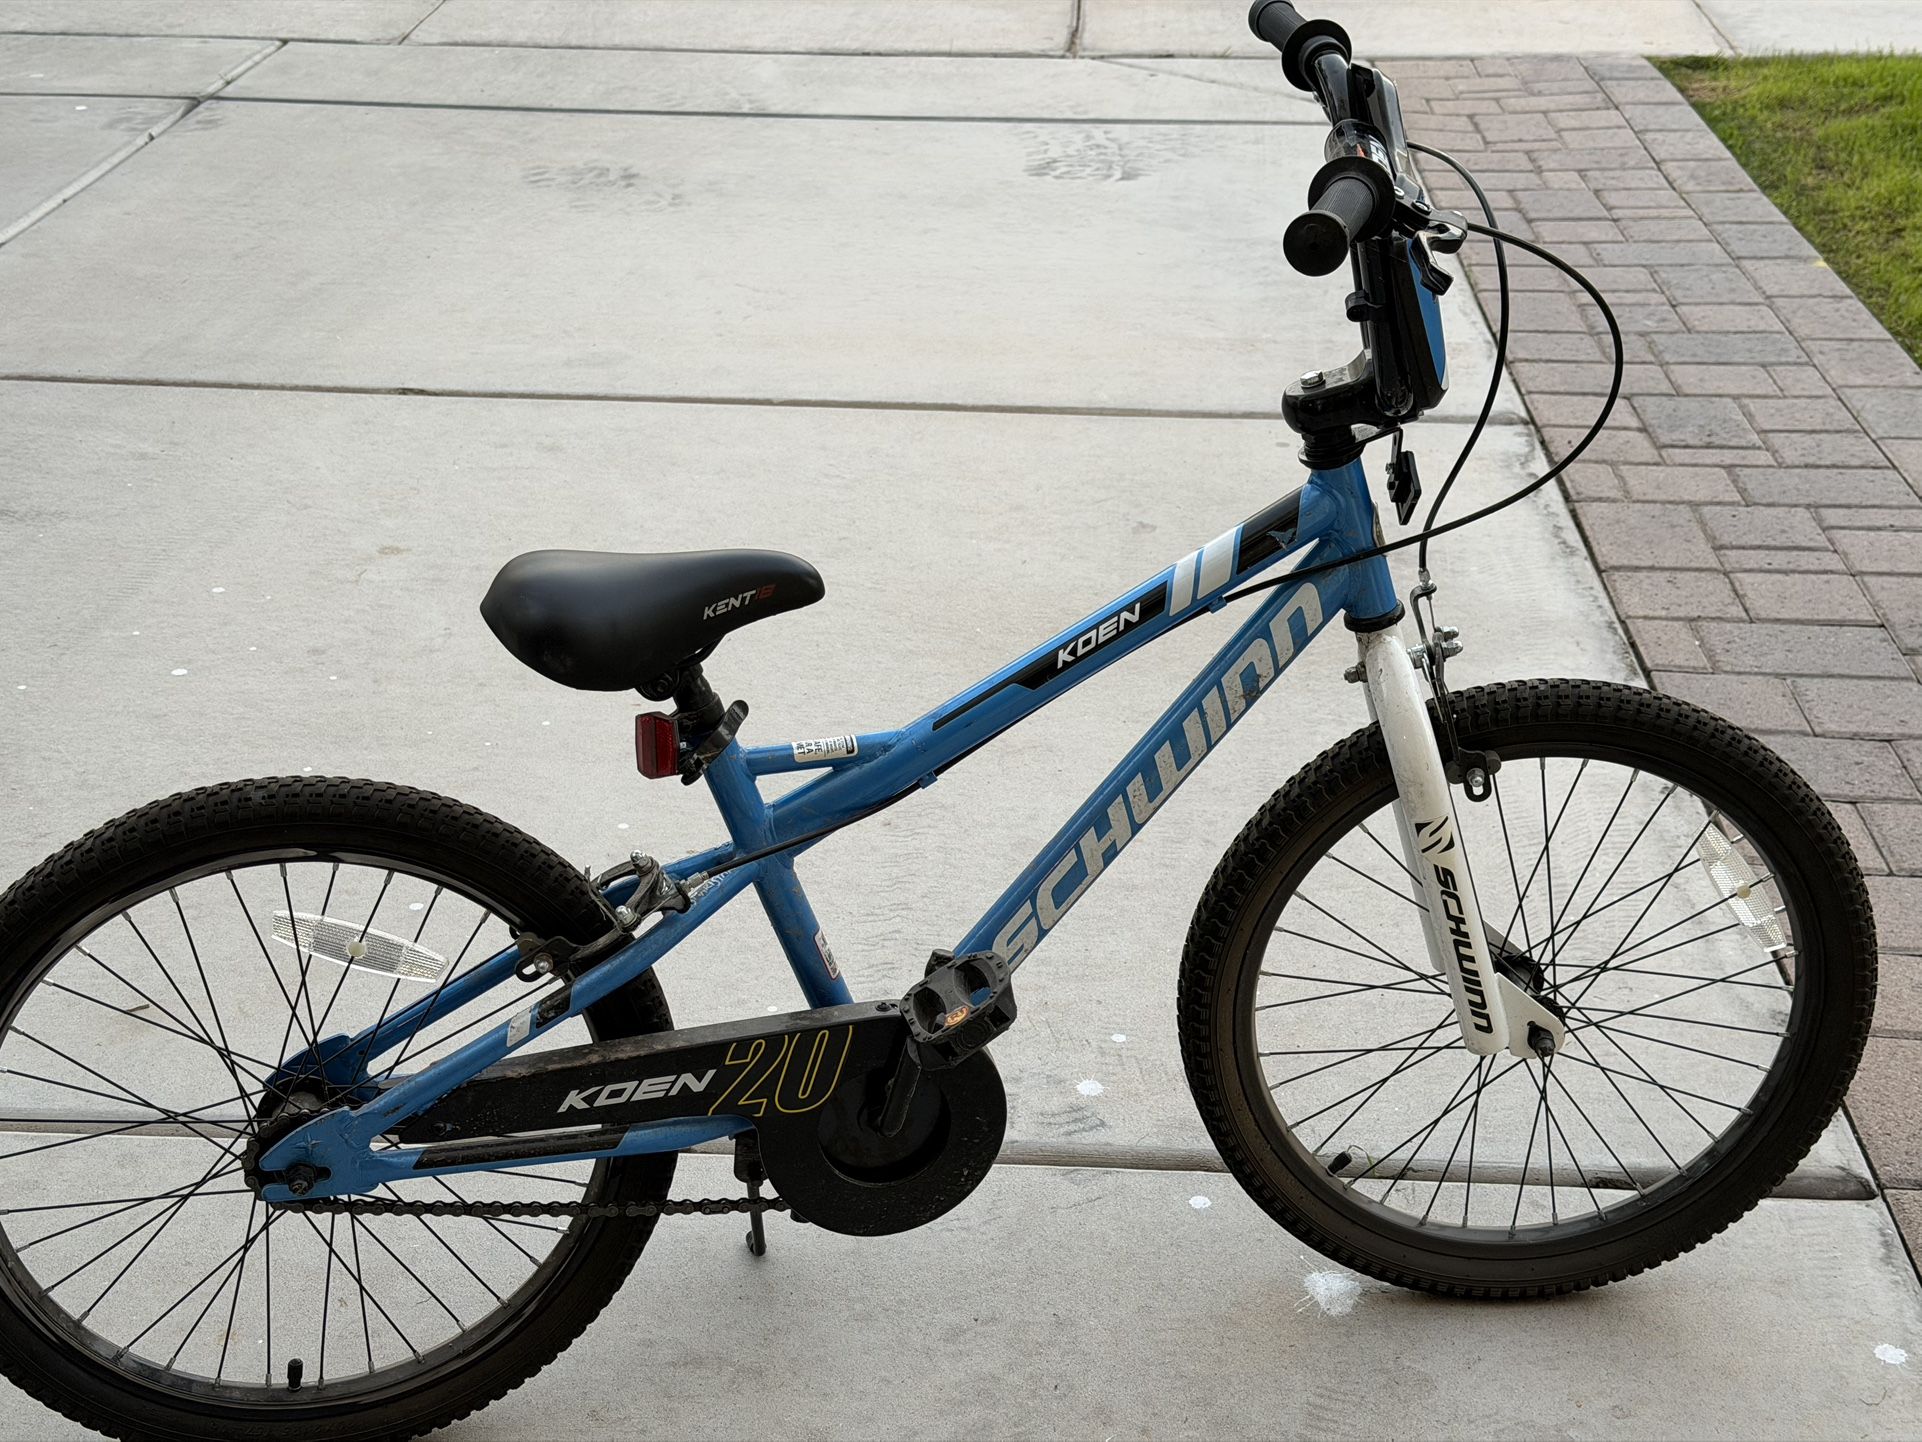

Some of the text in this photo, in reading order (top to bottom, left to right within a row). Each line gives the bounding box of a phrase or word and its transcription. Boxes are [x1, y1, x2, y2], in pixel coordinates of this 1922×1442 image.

[1057, 602, 1141, 669] KOEN
[992, 582, 1323, 969] SCHWINN
[1433, 864, 1493, 1034] SCHWINN
[557, 1025, 854, 1117] KOEN 20
